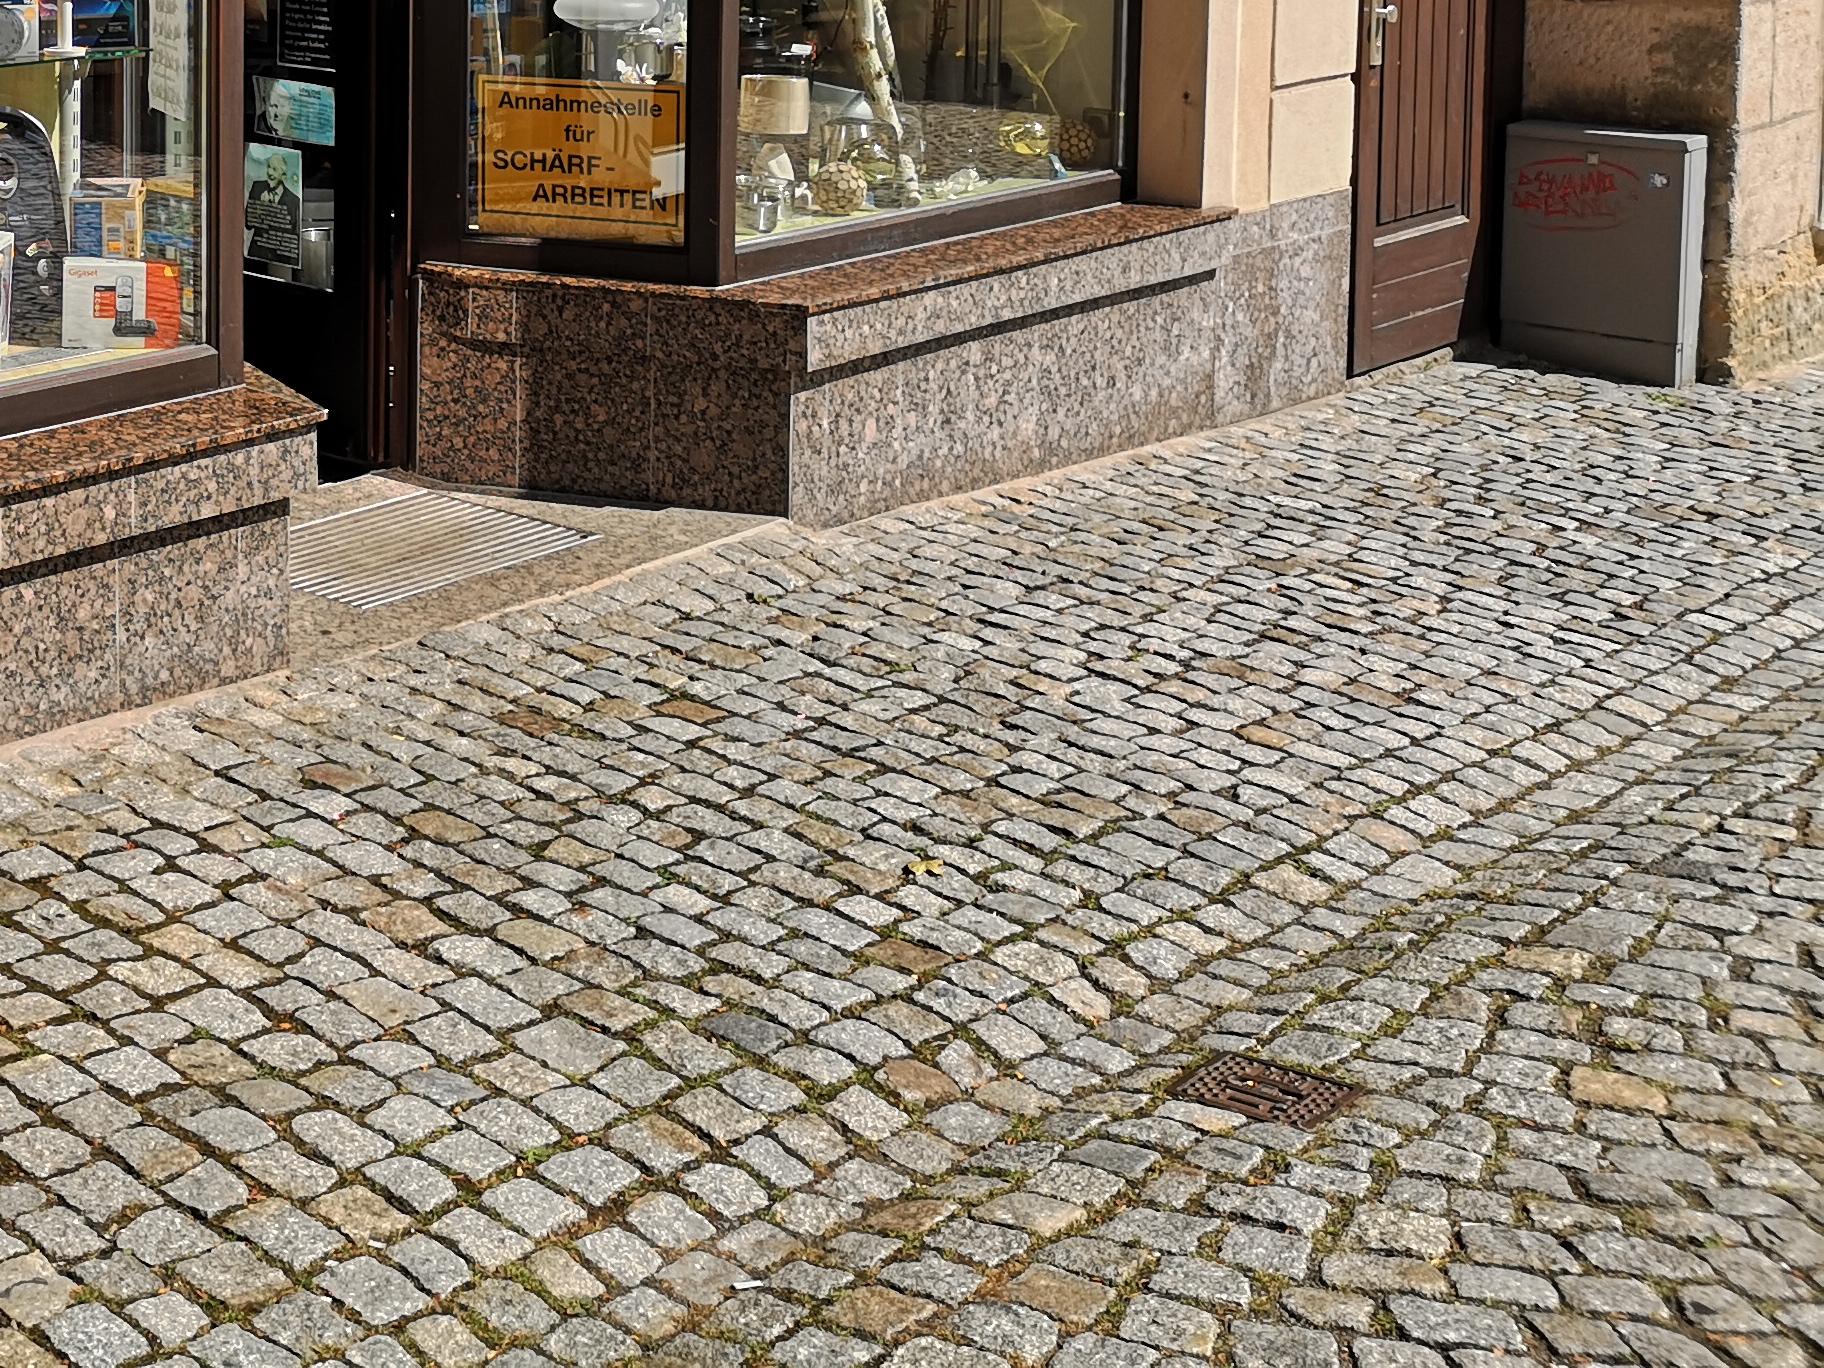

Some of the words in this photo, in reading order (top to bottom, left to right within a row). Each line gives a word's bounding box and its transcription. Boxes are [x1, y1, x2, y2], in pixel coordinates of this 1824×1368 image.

[497, 90, 663, 118] Annahmestelle
[563, 124, 596, 144] für
[531, 182, 669, 213] ARBEITEN
[68, 269, 98, 278] Gigaset
